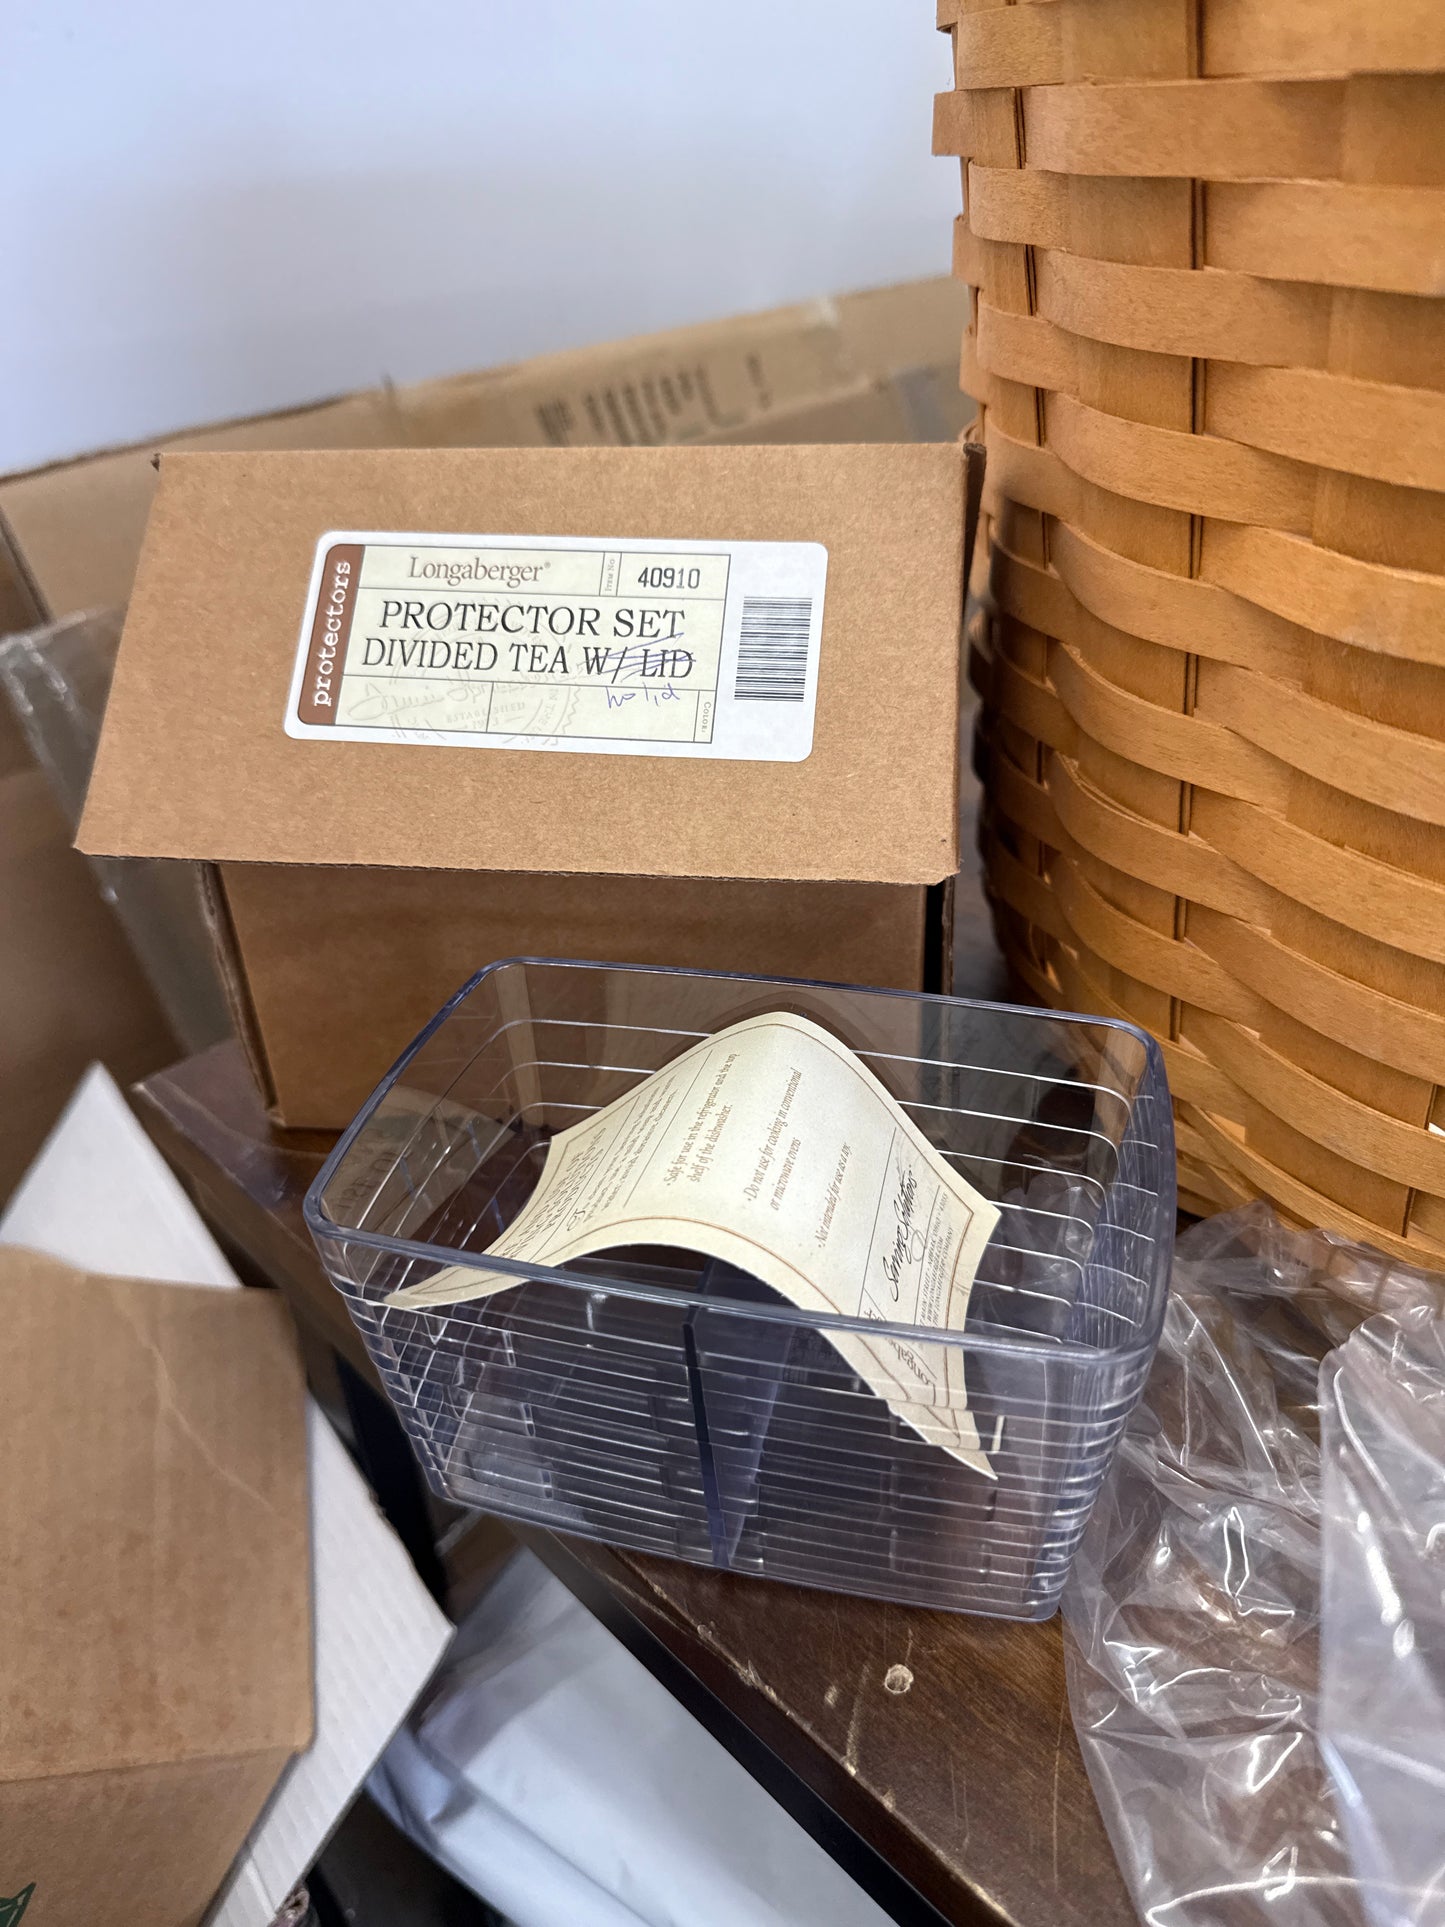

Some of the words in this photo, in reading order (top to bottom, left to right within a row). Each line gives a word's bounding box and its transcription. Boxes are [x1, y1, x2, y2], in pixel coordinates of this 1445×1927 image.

[638, 567, 701, 590] 40910
[379, 600, 601, 637] PROTECTOR
[613, 608, 686, 639] SET
[312, 560, 351, 708] protectors
[362, 637, 498, 671] DIVIDED
[508, 643, 569, 674] TEA
[639, 648, 693, 679] LID
[781, 1067, 802, 1111] conventional
[705, 1104, 732, 1142] dishwasher.
[774, 1109, 787, 1119] in
[664, 1166, 684, 1182] Safe
[681, 1142, 693, 1154] use
[689, 1121, 703, 1133] the
[697, 1086, 719, 1121] refrigerator
[767, 1118, 788, 1146] cooking
[696, 1154, 713, 1164] of
[699, 1143, 715, 1155] the
[759, 1144, 775, 1161] for
[788, 1137, 801, 1160] ovens
[687, 1163, 709, 1182] shelf
[759, 1155, 770, 1171] use
[753, 1169, 765, 1184] not
[772, 1157, 795, 1200] microwave
[743, 1183, 760, 1199] Do
[770, 1198, 780, 1211] or
[820, 1188, 838, 1230] intended
[815, 1226, 829, 1247] Not
